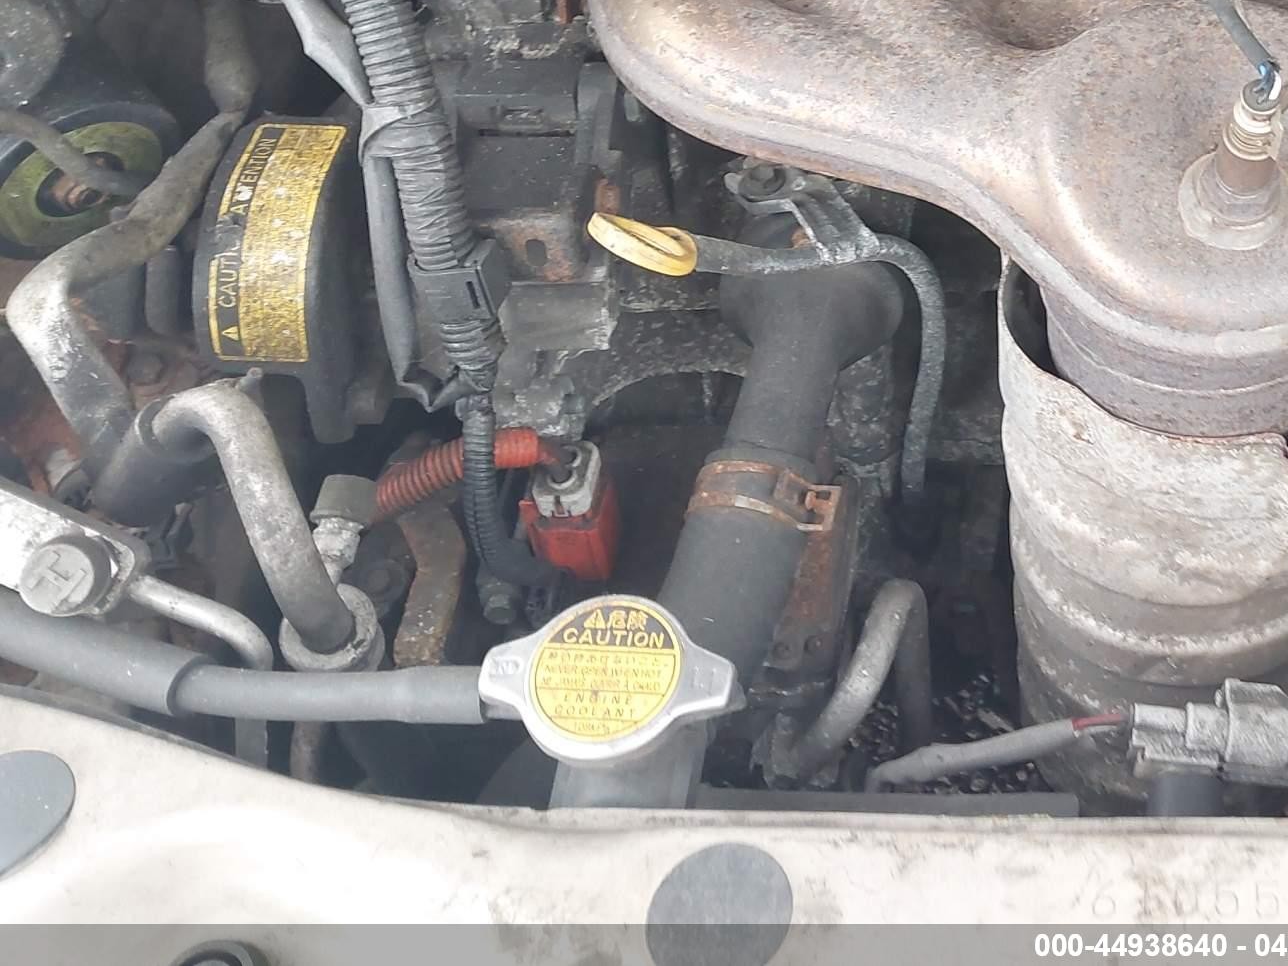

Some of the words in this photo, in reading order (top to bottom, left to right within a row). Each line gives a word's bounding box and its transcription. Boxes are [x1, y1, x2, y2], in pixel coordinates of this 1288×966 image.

[563, 628, 665, 648] CAUTION
[563, 692, 633, 706] ENGINE
[553, 706, 636, 719] COOLANT
